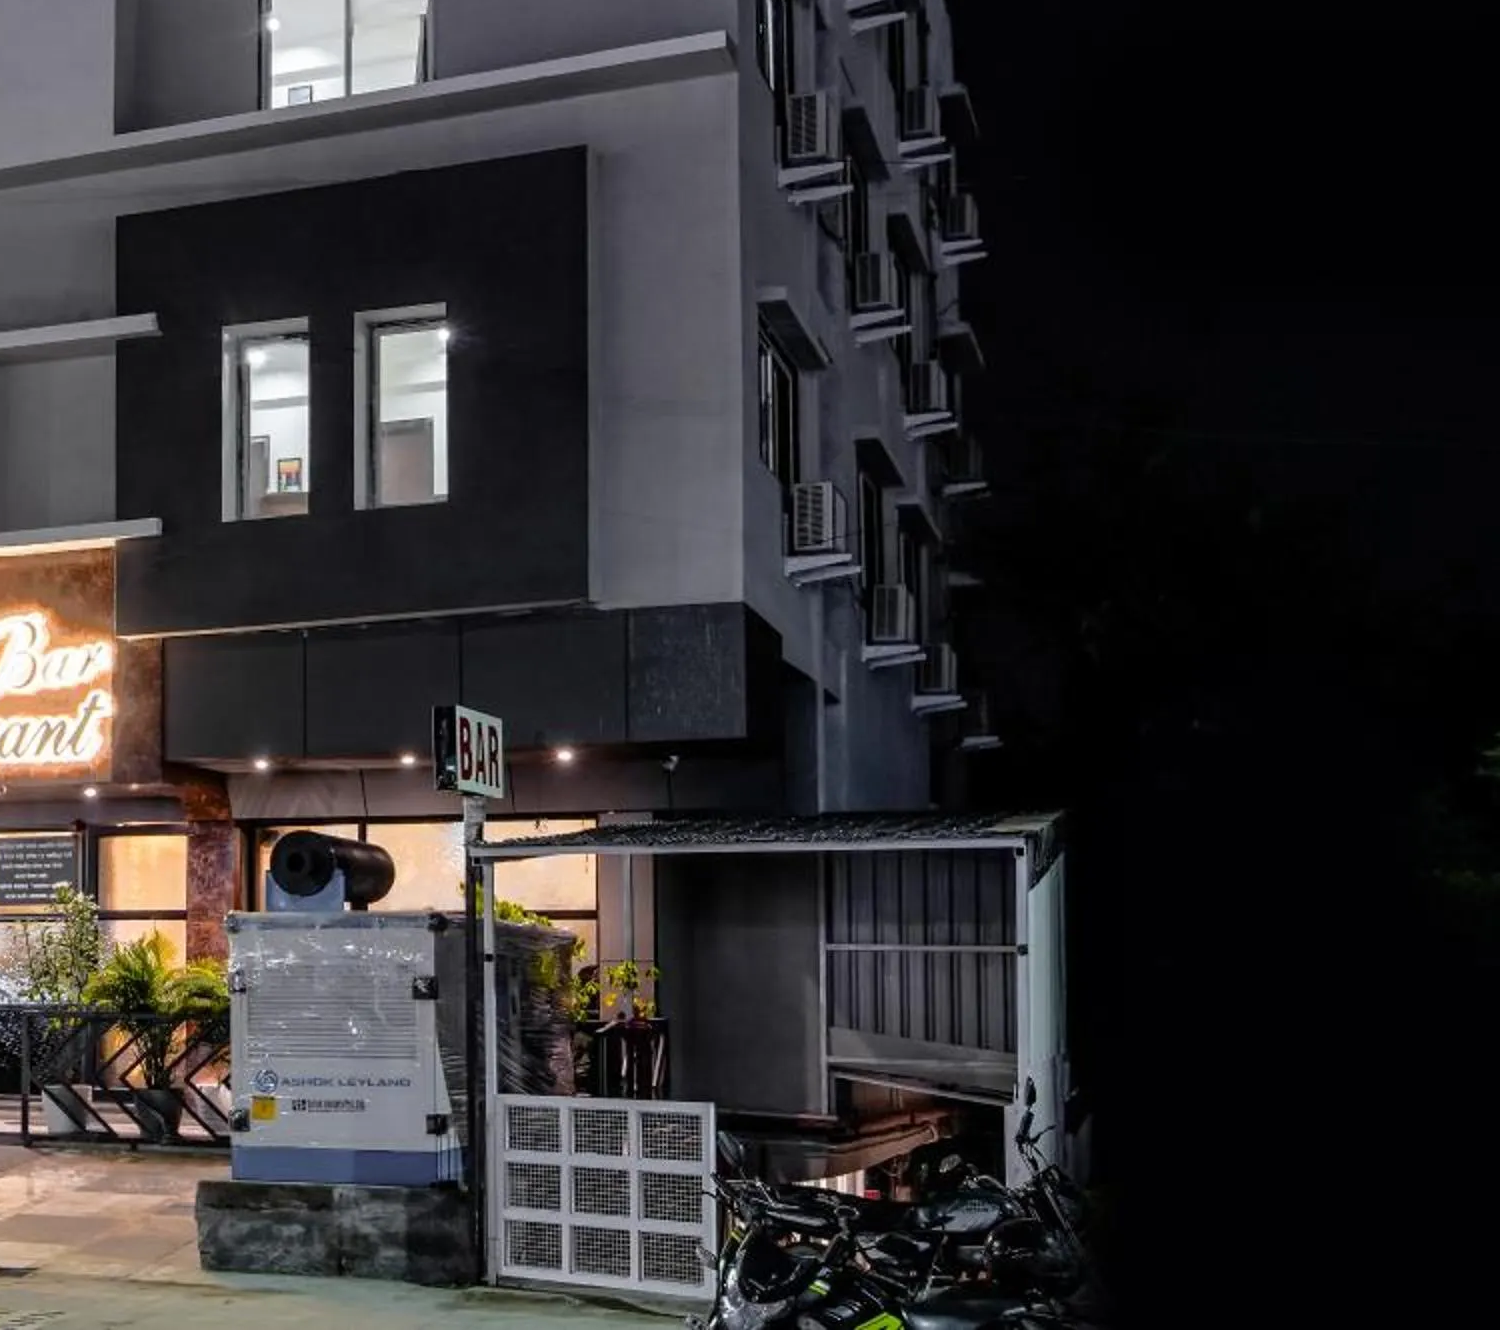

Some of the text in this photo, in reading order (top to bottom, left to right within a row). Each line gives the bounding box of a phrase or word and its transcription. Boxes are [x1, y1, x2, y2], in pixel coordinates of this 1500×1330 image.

[459, 716, 500, 788] BAR
[280, 1074, 411, 1087] ASHOK LEYLAND
